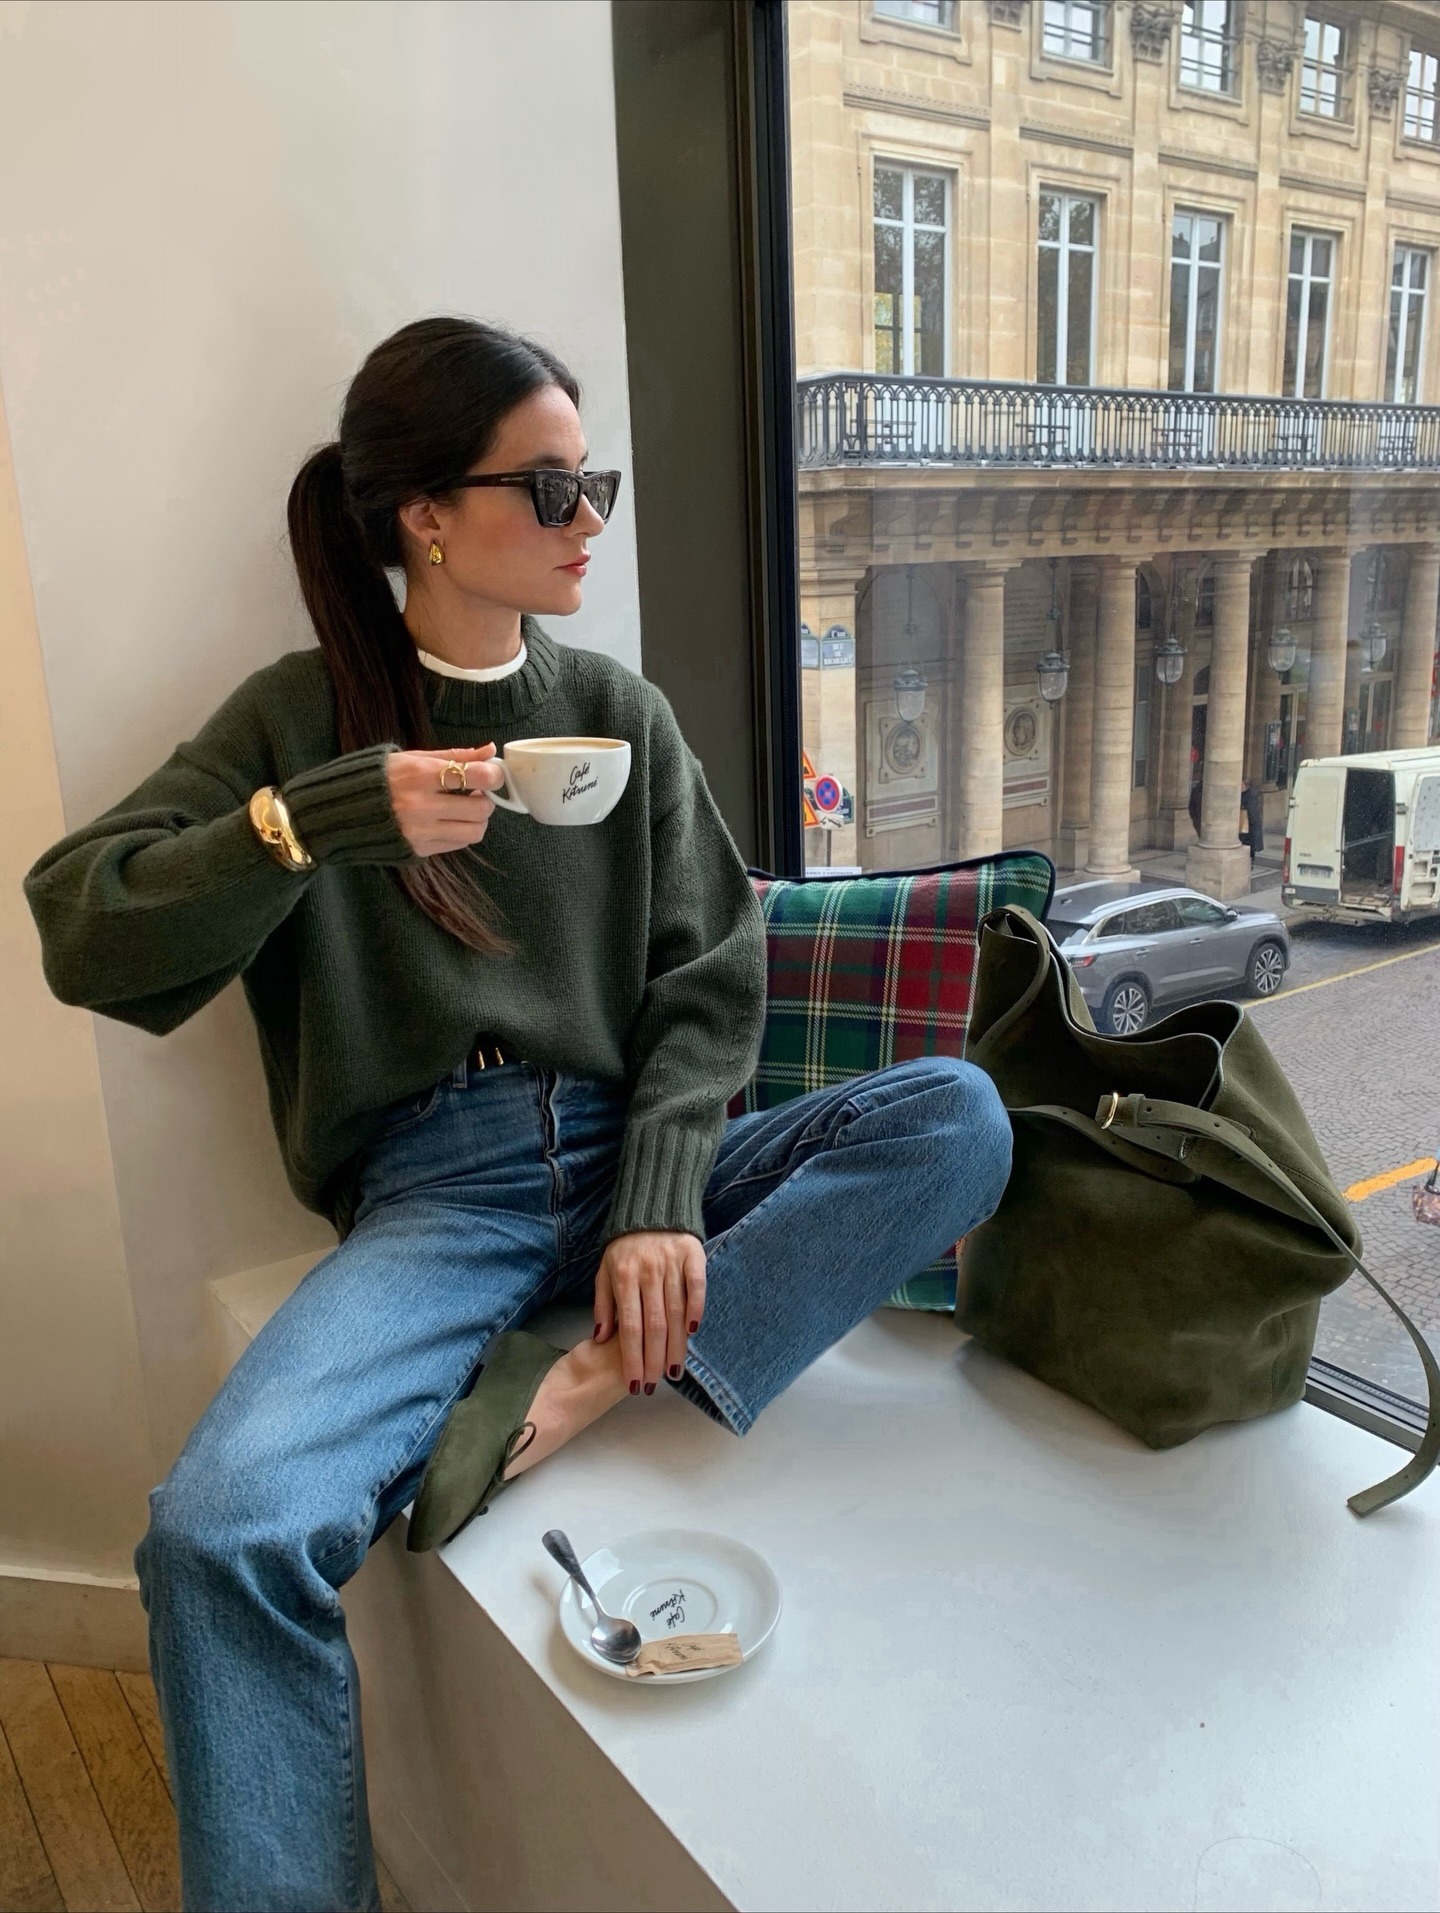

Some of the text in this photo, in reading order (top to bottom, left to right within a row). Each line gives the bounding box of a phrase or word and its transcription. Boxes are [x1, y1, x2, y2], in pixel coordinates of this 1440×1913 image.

[569, 762, 591, 786] Café
[562, 776, 599, 804] Kitsuné
[649, 1588, 686, 1621] Kitsuné
[666, 1605, 685, 1629] Café
